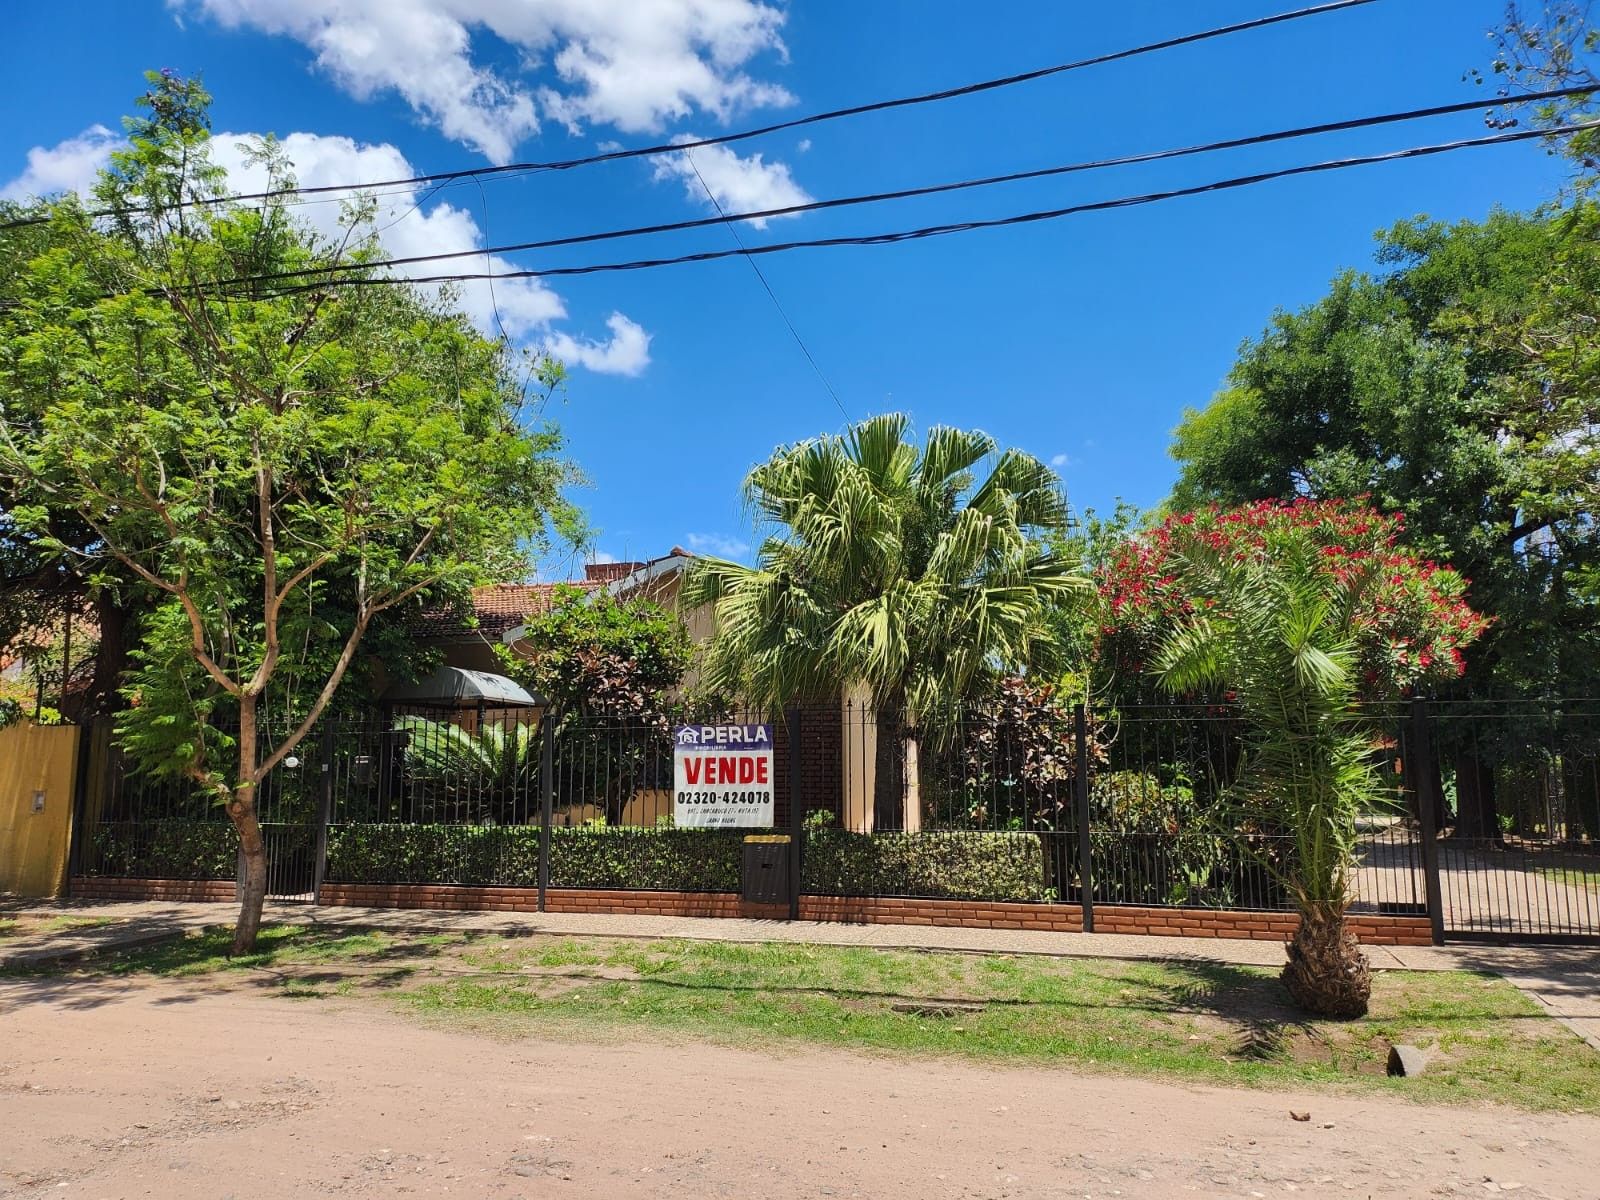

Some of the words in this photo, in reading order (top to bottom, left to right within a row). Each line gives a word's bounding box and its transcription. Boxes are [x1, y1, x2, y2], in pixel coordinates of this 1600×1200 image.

[701, 726, 768, 744] PERLA
[684, 757, 768, 785] VENDE
[678, 791, 770, 804] 02320-424078
